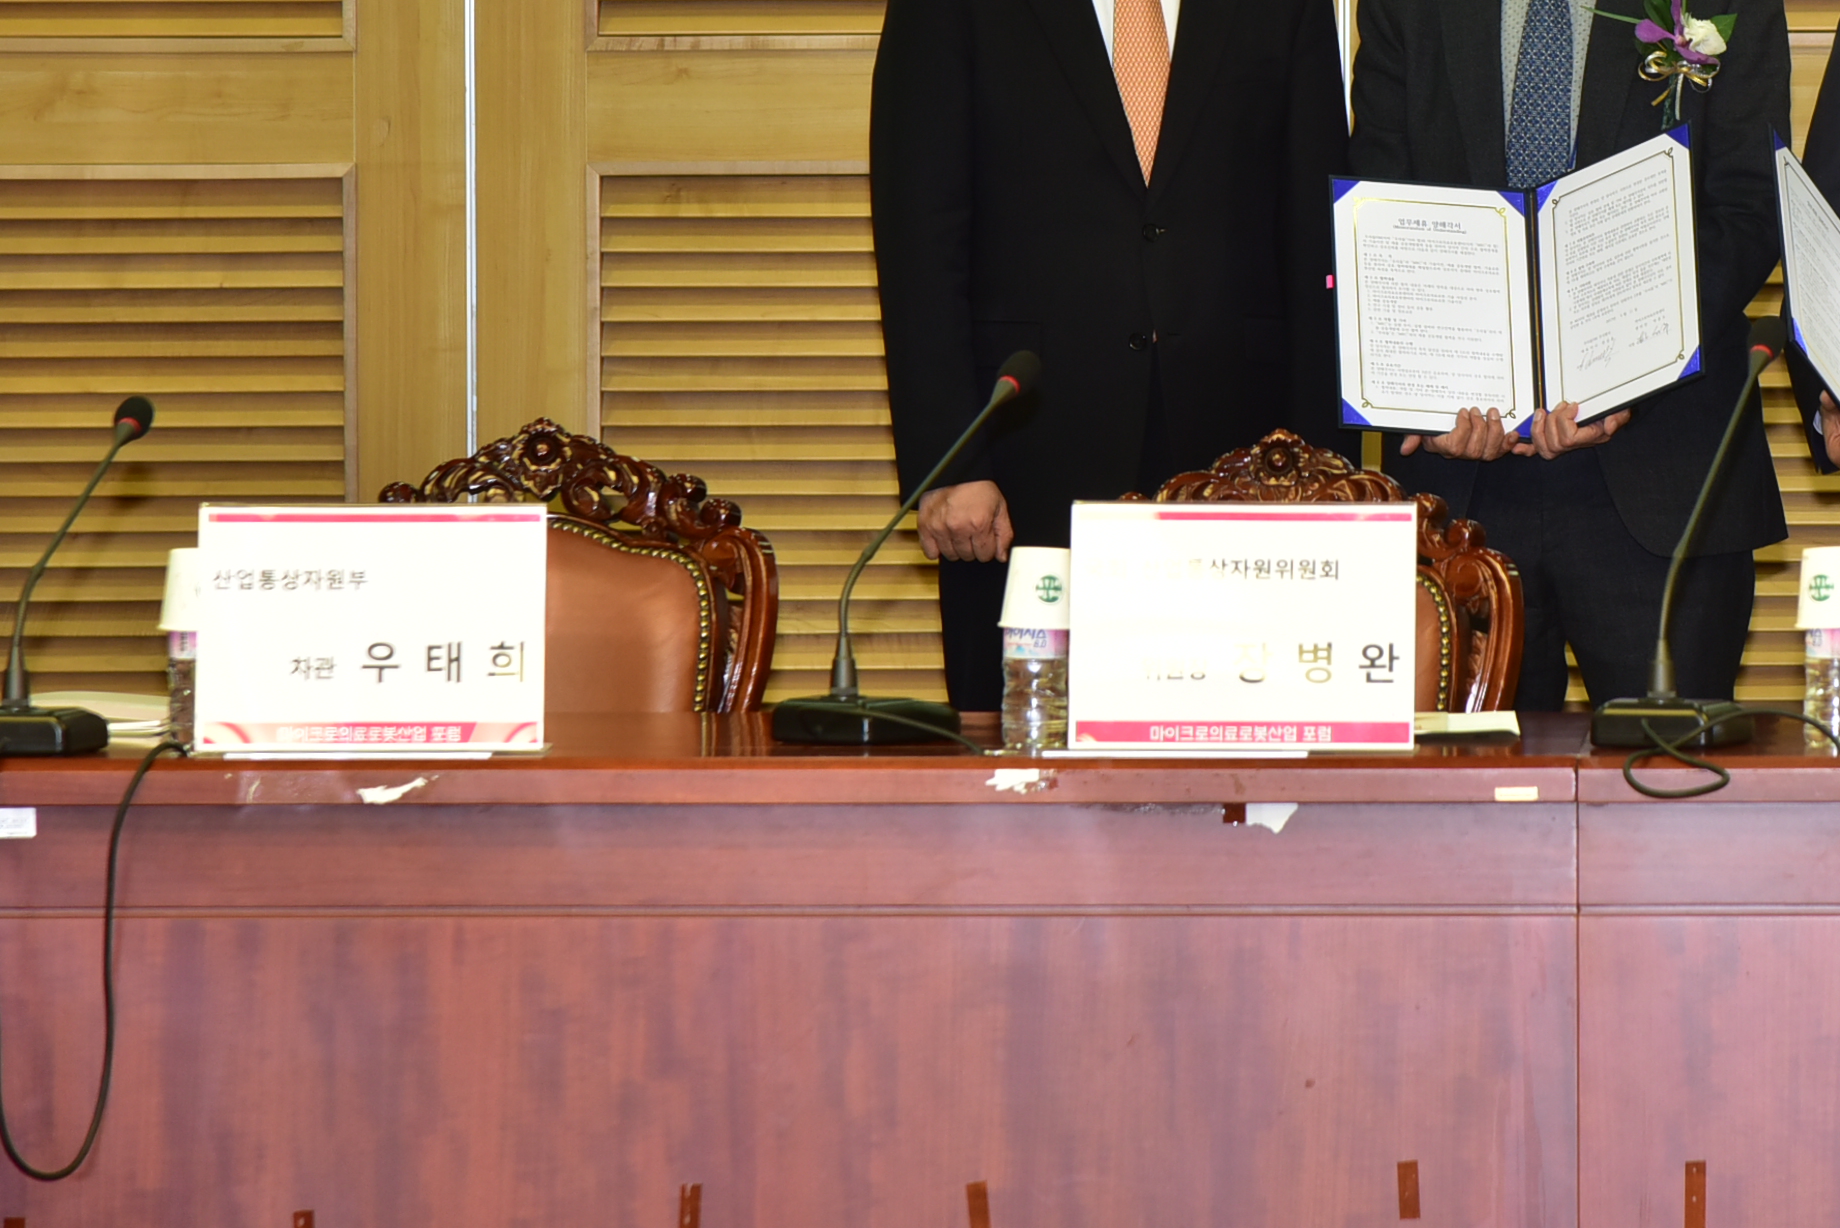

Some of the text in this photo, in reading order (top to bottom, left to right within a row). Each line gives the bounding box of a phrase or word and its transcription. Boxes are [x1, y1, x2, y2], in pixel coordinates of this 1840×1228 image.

[212, 568, 367, 591] 산업통상자원부
[289, 656, 338, 681] 차관
[431, 726, 462, 743] 포럼
[1150, 725, 1332, 742] 마이크로의료로봇산업 포럼
